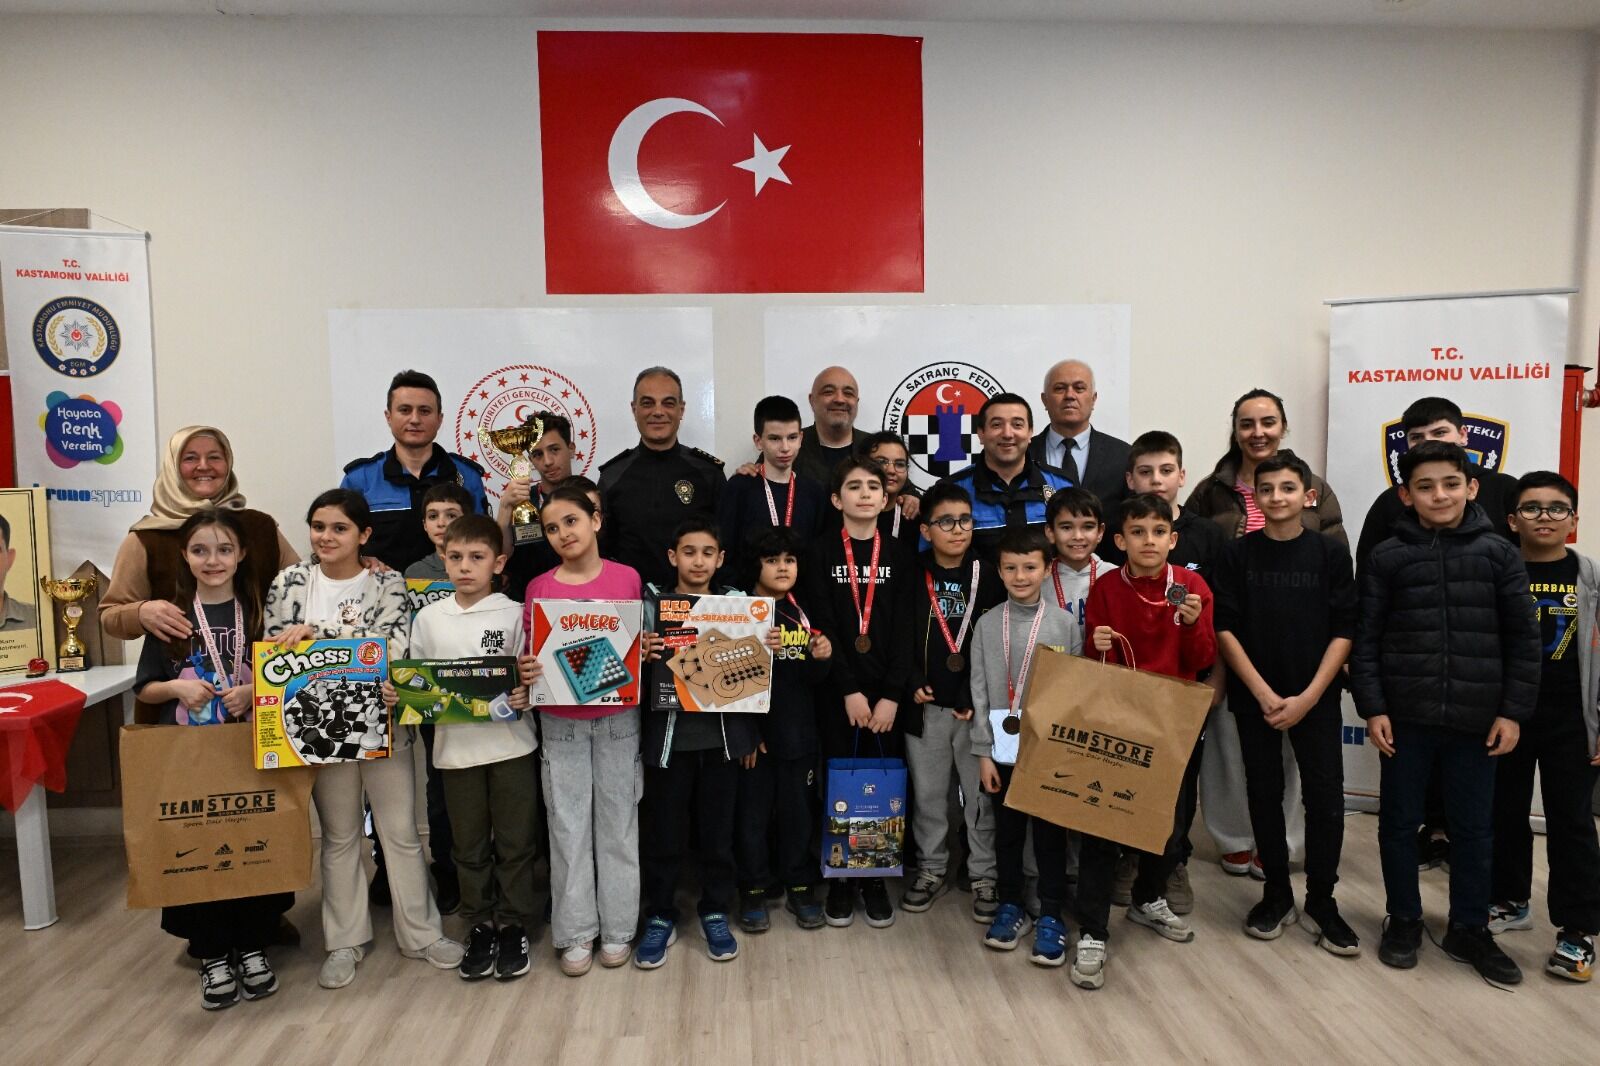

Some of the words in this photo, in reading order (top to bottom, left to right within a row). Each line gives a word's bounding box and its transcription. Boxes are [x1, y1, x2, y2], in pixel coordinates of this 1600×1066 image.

[63, 259, 80, 268] T.C.
[16, 269, 81, 281] KASTAMONU
[85, 272, 129, 282] VALİLİĞİ
[1430, 347, 1464, 360] T.C.
[906, 367, 960, 392] SATRANÇ
[1348, 367, 1463, 383] KASTAMONU
[1469, 363, 1550, 380] VALİLİĞİ
[512, 391, 550, 403] GENÇLİK
[551, 401, 561, 413] VE
[57, 407, 101, 423] Hayata
[62, 422, 102, 439] Renk
[1466, 424, 1502, 440] TEKLİ
[61, 441, 104, 454] Verelim
[560, 613, 620, 632] SPHERE
[484, 630, 504, 640] SHAPE
[481, 639, 505, 649] FUTURE
[263, 648, 352, 684] Chess
